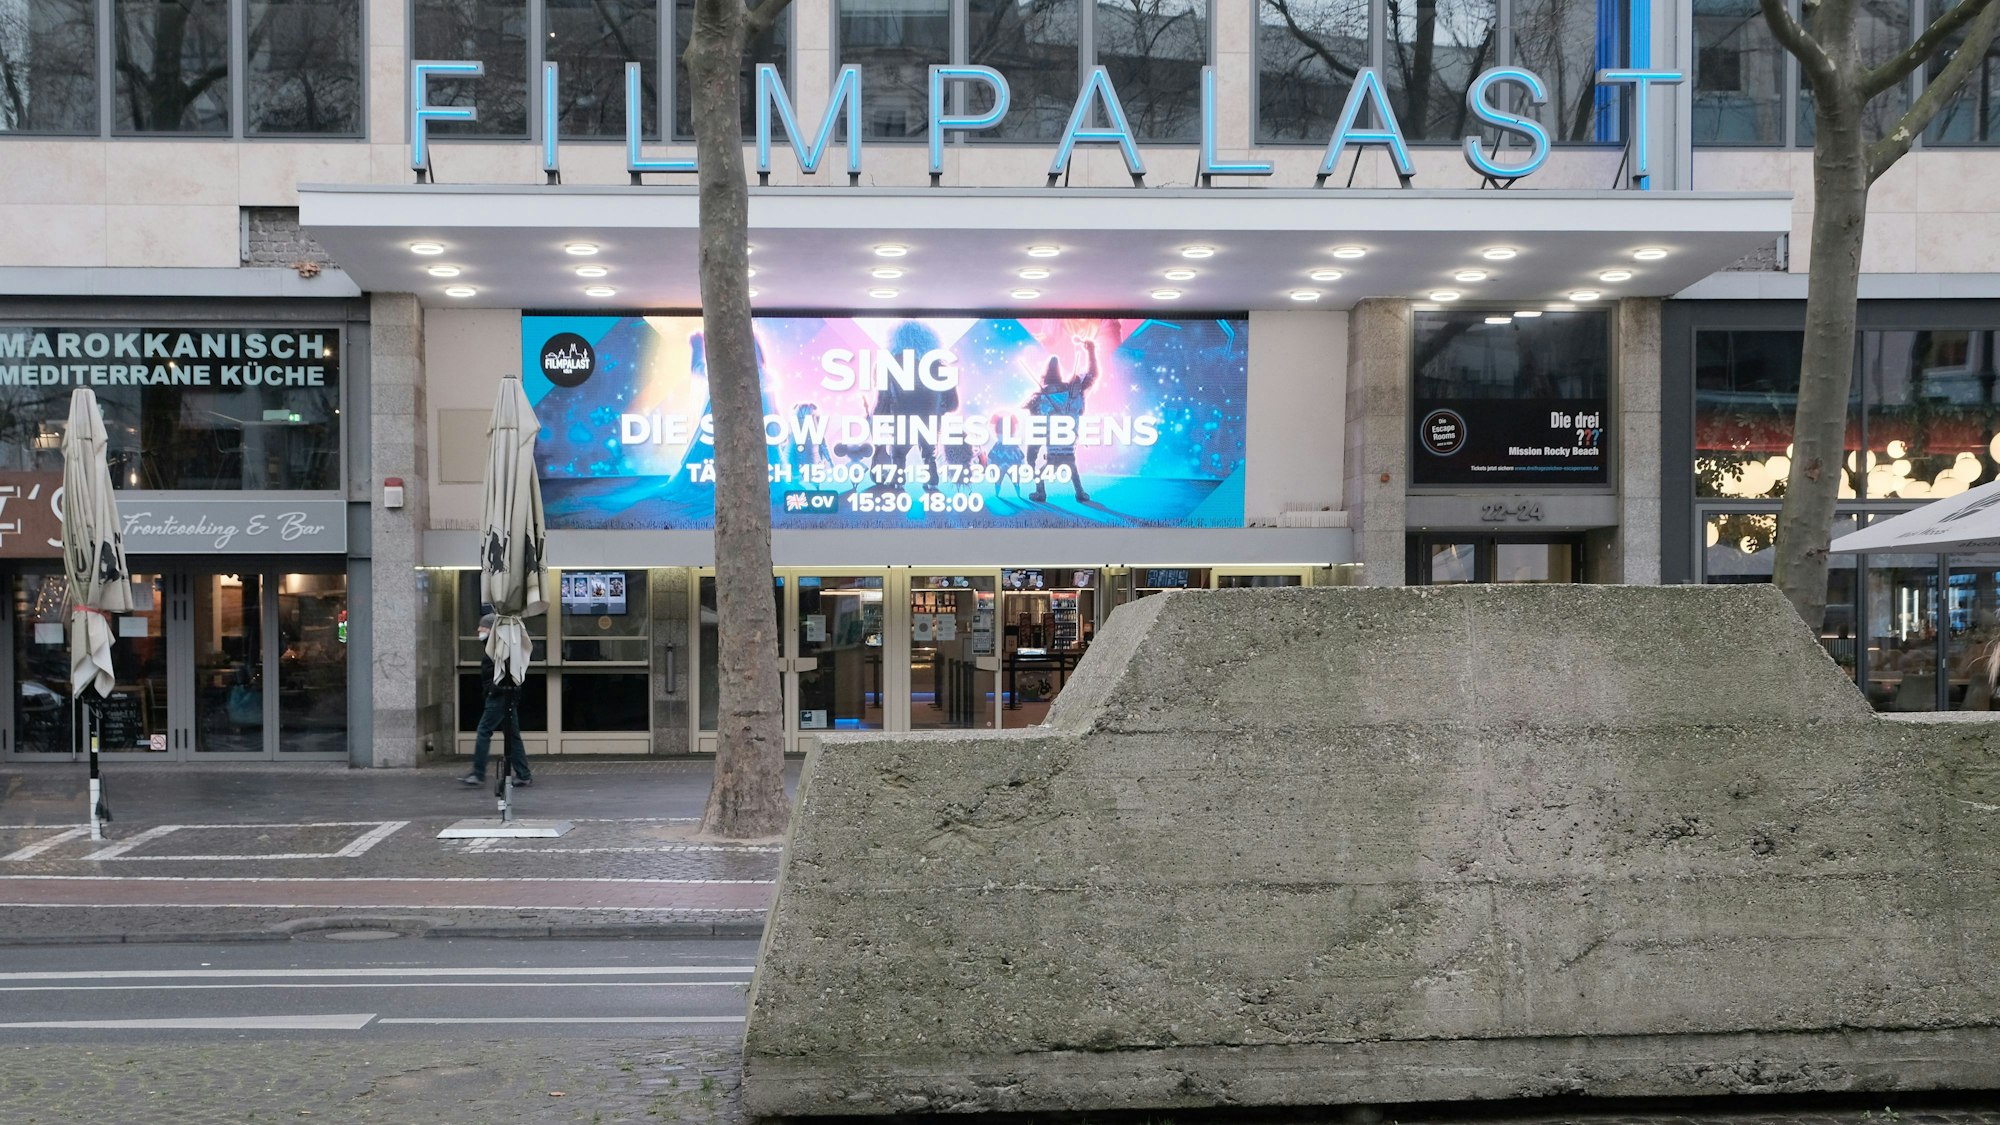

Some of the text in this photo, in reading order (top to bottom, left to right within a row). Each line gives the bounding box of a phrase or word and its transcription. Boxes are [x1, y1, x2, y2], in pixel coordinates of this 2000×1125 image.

[409, 60, 1685, 178] FILMPALAST
[0, 333, 325, 359] MAROKKANISCH
[0, 361, 325, 386] MEDITERRANE KÜCHE
[545, 358, 590, 369] FILMPALAST
[820, 348, 959, 392] SING
[621, 413, 1159, 447] DIE SOW DEINES LEBENS
[1431, 425, 1455, 433] Escape
[1551, 412, 1599, 428] Die drei
[1433, 433, 1455, 441] Rooms
[1508, 447, 1599, 457] Mission Rocky Beach
[799, 463, 865, 484] 15:00
[872, 463, 931, 484] 17:15
[939, 463, 1000, 484] 17:30
[1008, 464, 1073, 484] 19:40
[811, 496, 835, 509] OV
[847, 492, 984, 513] 15:30 18:00
[1481, 502, 1544, 522] 22-24
[123, 511, 325, 549] Frontcooking & Bar
